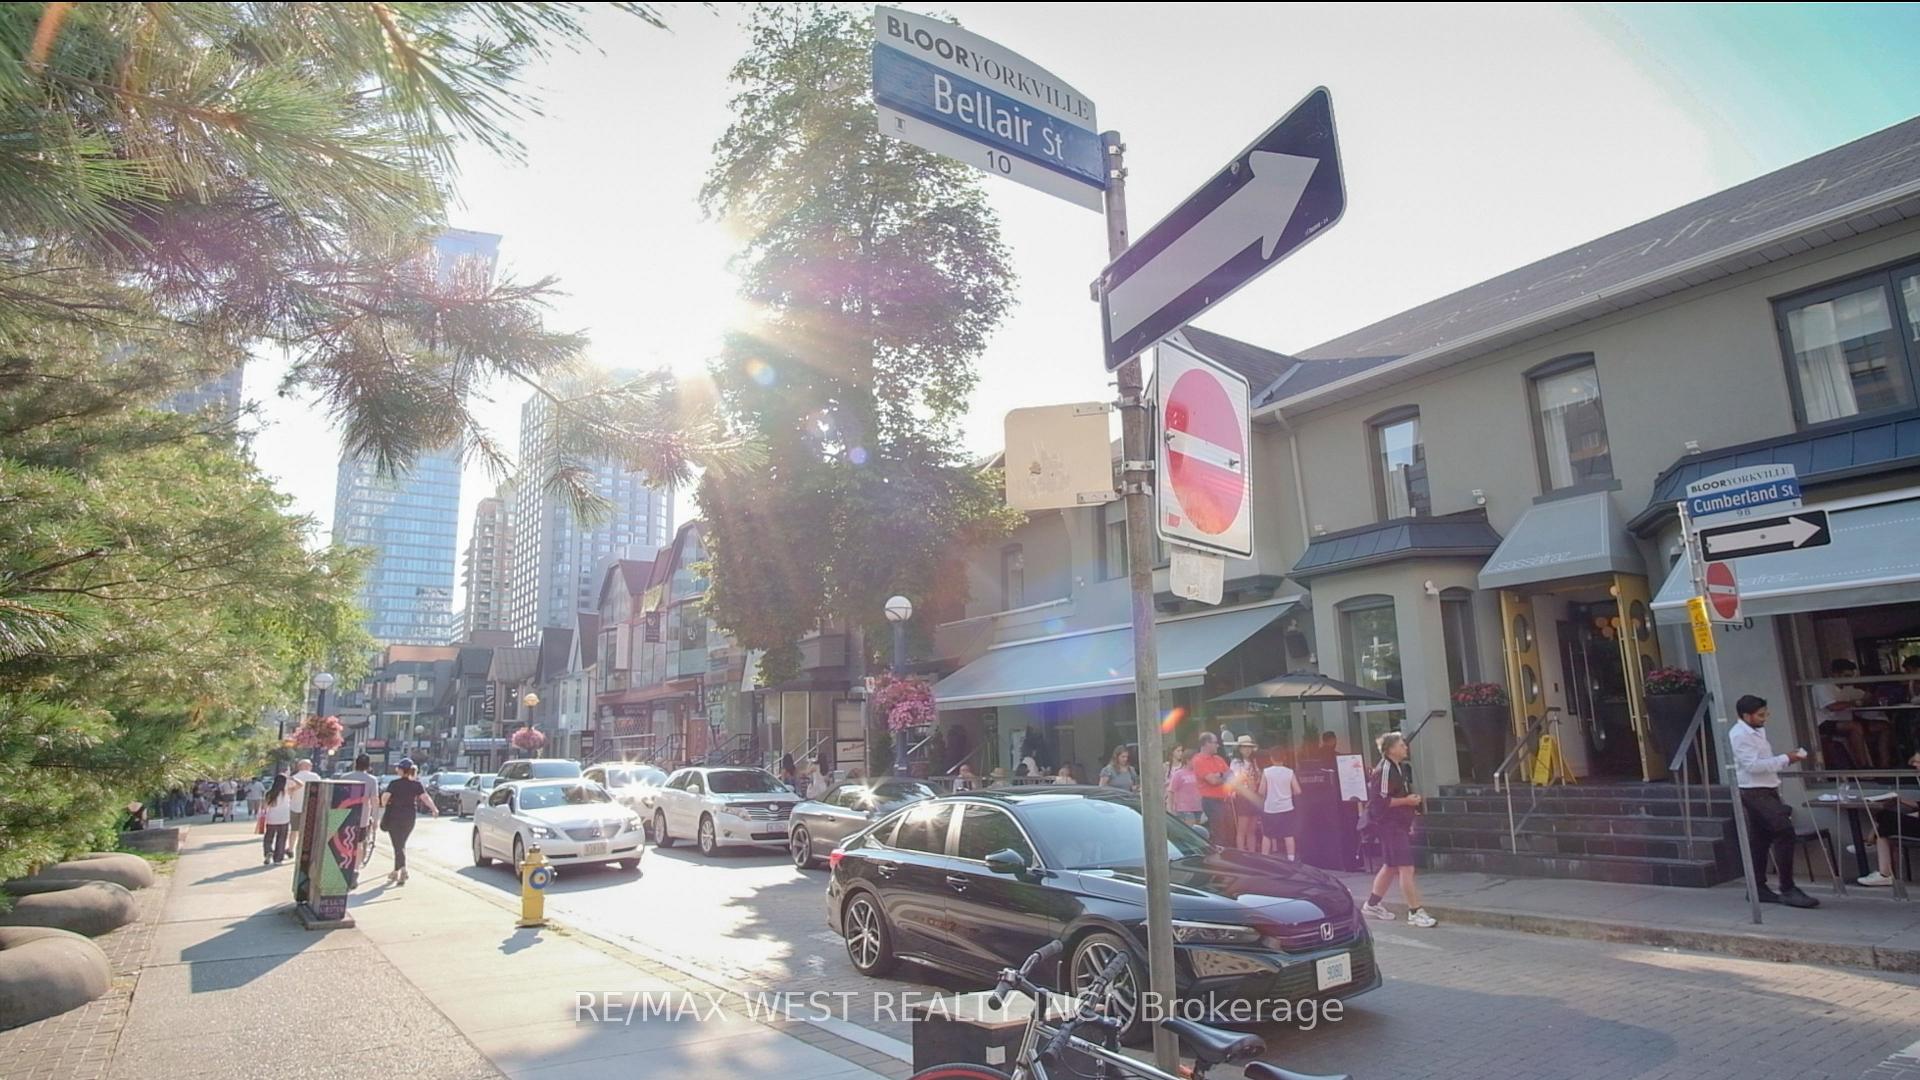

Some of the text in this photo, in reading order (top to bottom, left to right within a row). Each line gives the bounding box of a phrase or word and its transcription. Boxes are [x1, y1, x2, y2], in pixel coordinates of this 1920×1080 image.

[887, 15, 1090, 121] BLOORYORKVILLE
[933, 73, 1064, 161] Bellair St
[986, 150, 1012, 175] 10
[1691, 467, 1790, 493] BLOORYORKVILLE
[1693, 484, 1794, 513] Cumberland St
